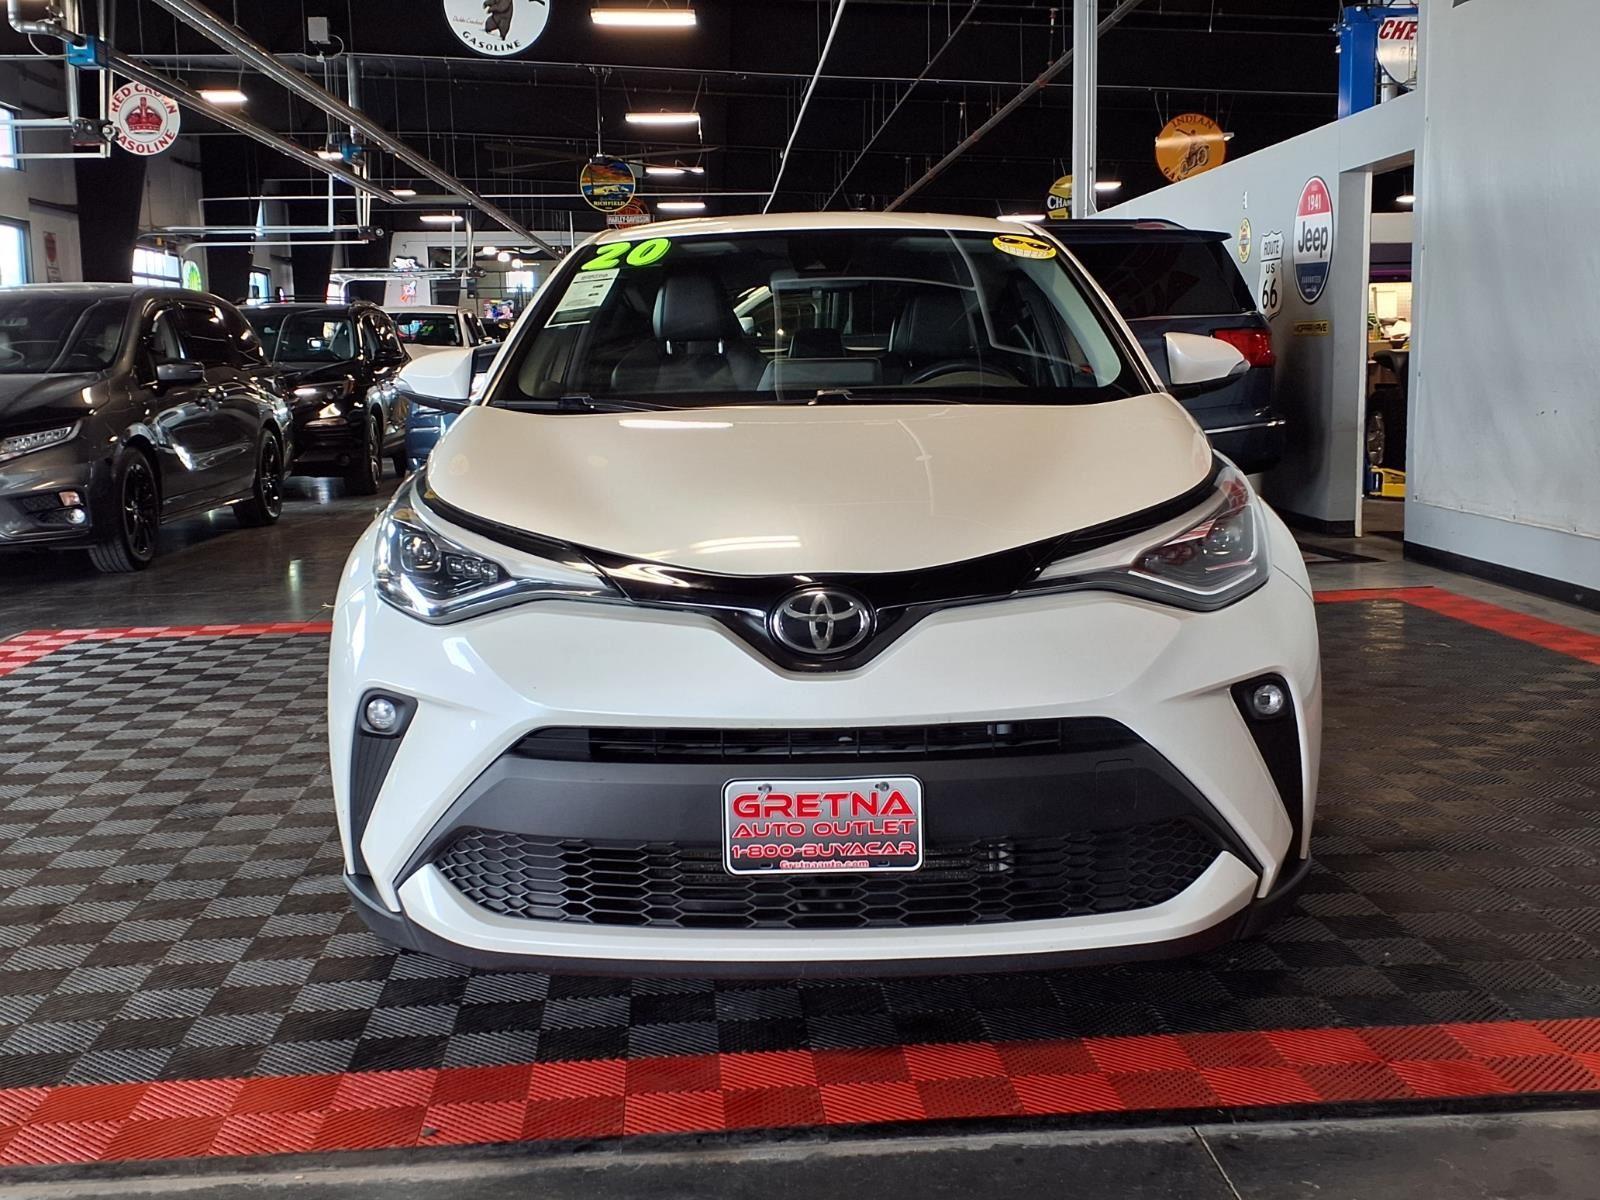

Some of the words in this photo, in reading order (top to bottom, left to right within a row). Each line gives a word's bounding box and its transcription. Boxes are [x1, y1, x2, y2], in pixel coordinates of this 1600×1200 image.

[462, 31, 521, 52] GASOLINE
[1172, 115, 1215, 130] INDIAN
[117, 129, 176, 153] ASOLINE
[1046, 195, 1071, 210] CHA
[1308, 194, 1322, 211] 1941
[1264, 240, 1280, 256] ROUTE
[1298, 221, 1329, 259] Jeep
[581, 238, 672, 271] 20
[1265, 263, 1276, 274] US
[1262, 277, 1278, 309] 66
[732, 790, 916, 819] GRETNA
[732, 821, 805, 839] AUTO
[812, 819, 917, 836] OUTLET
[731, 841, 917, 859] 1-800-BUYACAR
